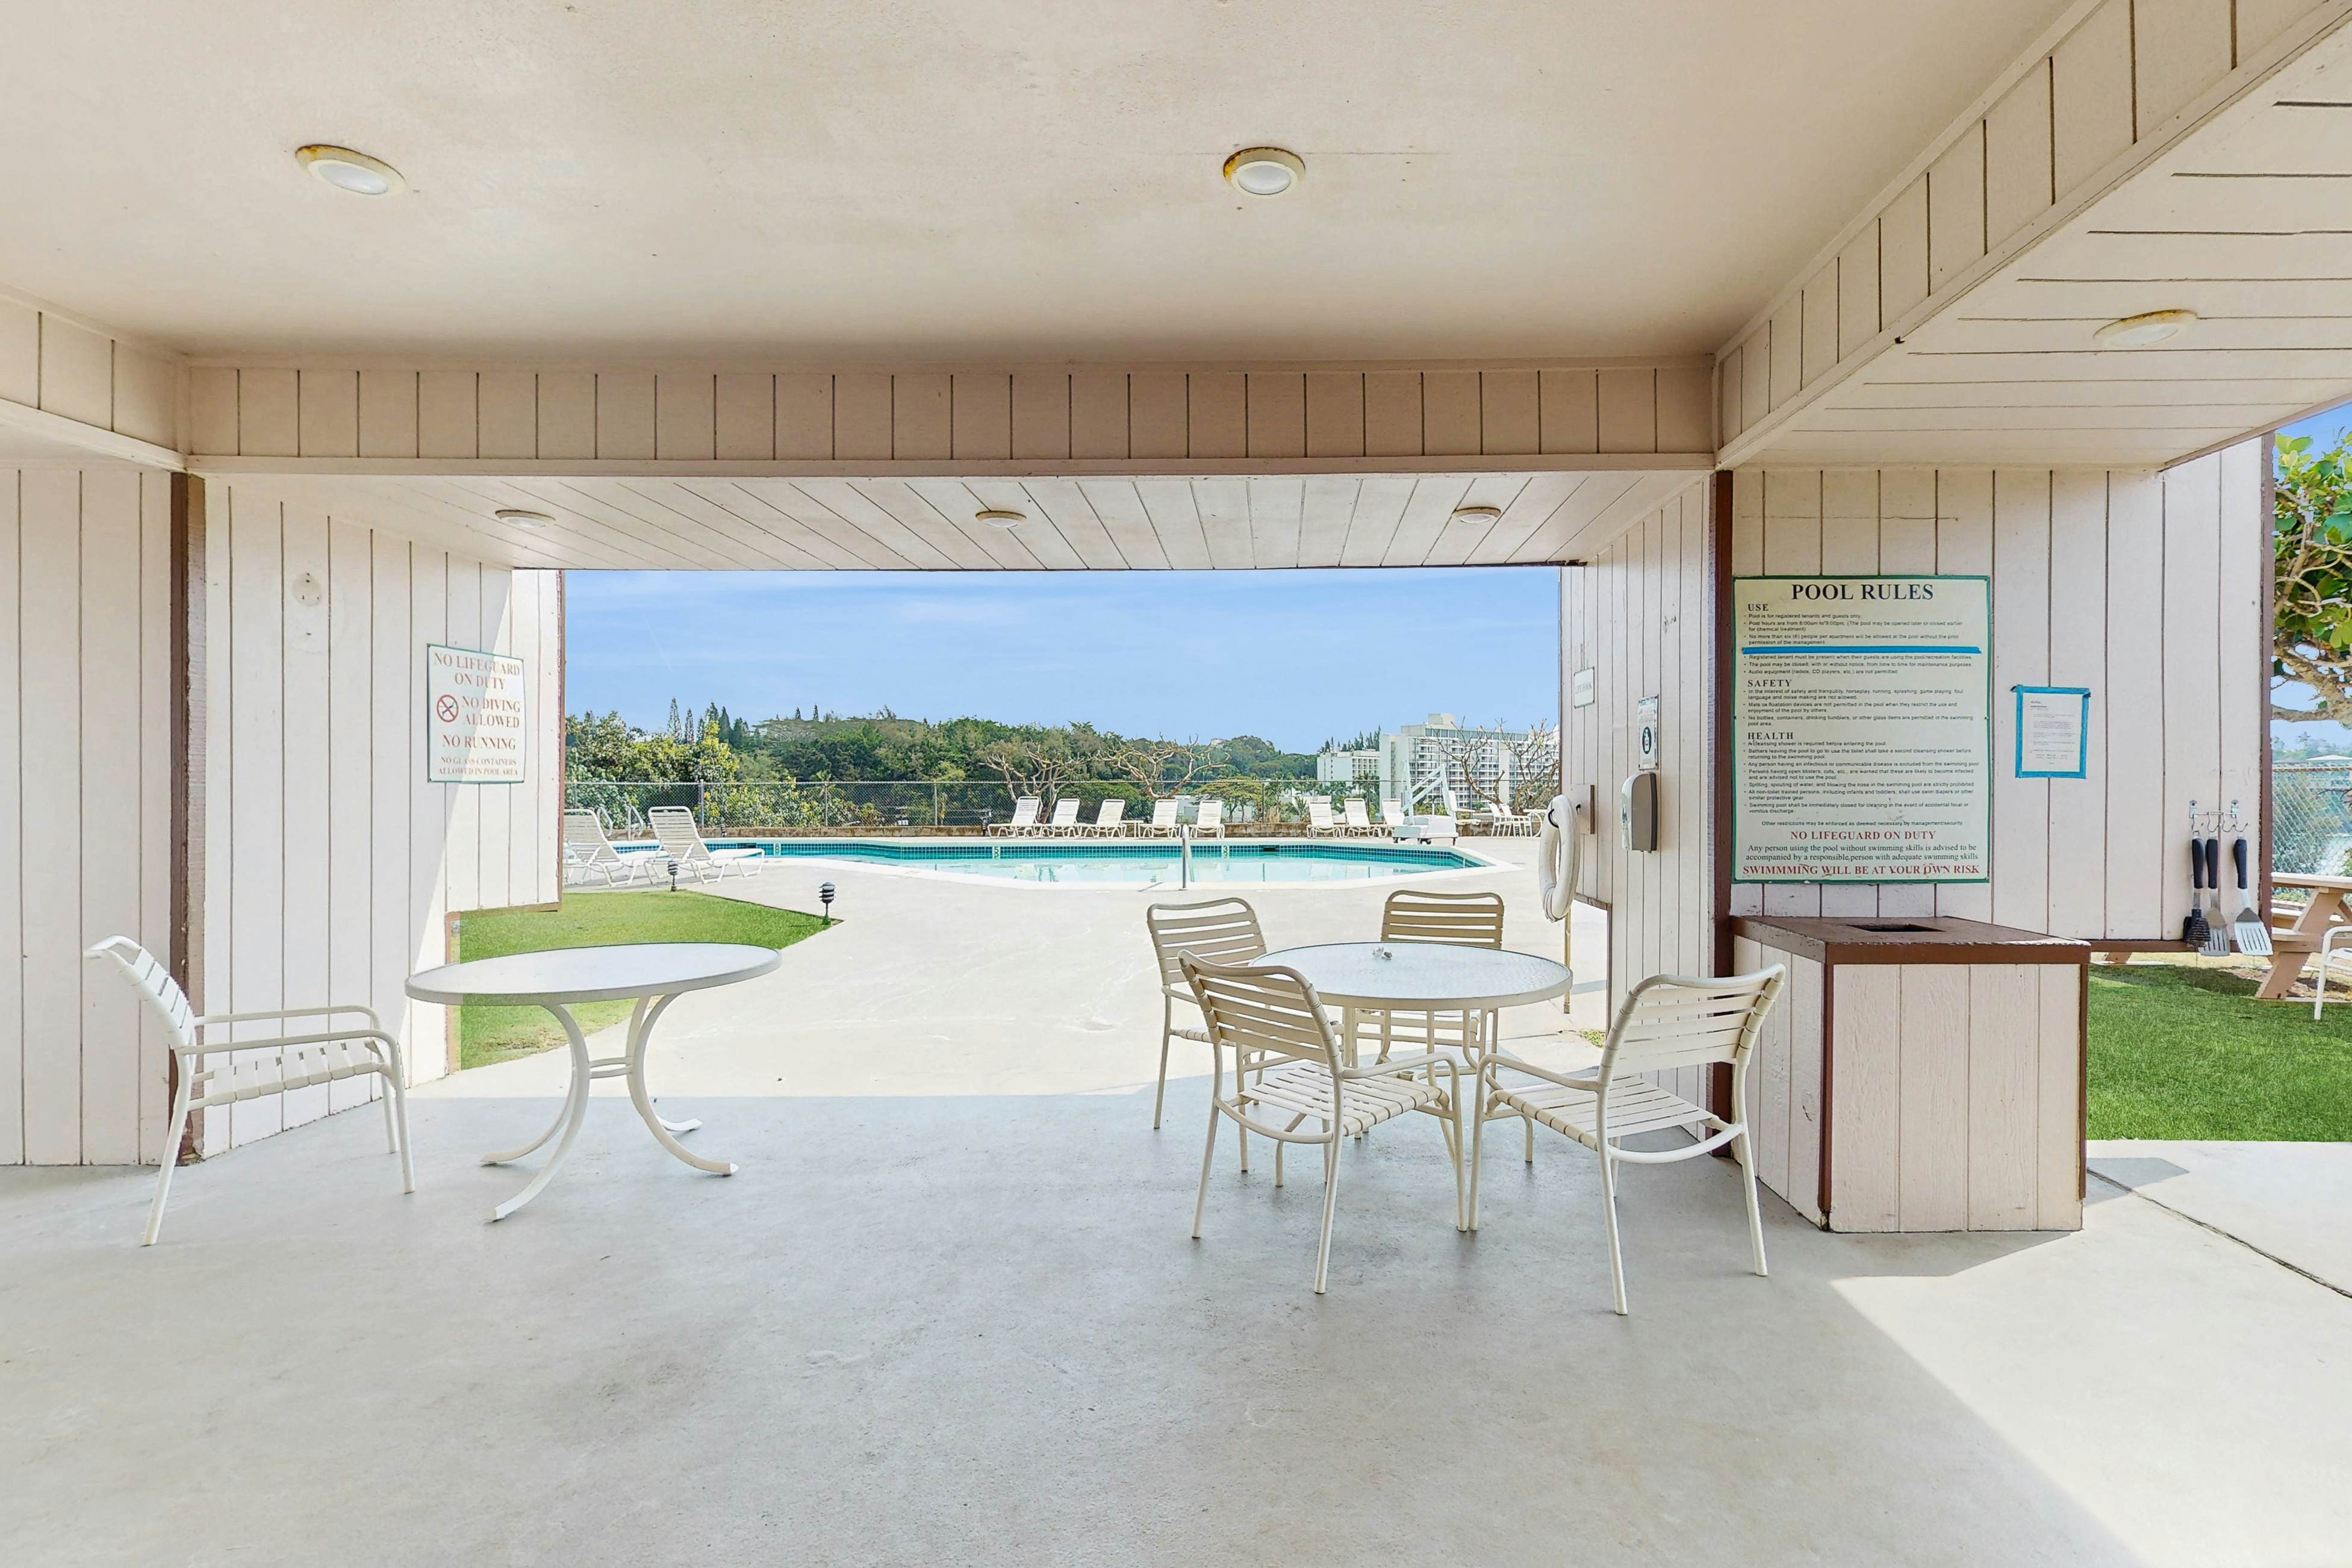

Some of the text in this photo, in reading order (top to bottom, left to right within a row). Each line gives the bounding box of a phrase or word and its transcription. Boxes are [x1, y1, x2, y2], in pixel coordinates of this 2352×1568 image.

[1791, 583, 1934, 600] POOL RULES
[434, 652, 520, 676] NO LIFEGUARD
[455, 673, 506, 690] ON DUTY
[462, 695, 521, 713] NO DIVING
[463, 714, 520, 728] ALLOWED
[443, 735, 516, 750] NO RUNNING
[1791, 831, 1935, 839] NO LIFEGUARD ON DUTY
[1823, 844, 1838, 853] pool
[1868, 844, 1903, 853] swimming
[1960, 844, 1967, 852] to
[1968, 844, 1976, 852] be
[1892, 853, 1922, 862] adequate
[1924, 853, 1958, 862] swimming
[1822, 866, 1851, 874] WILL
[1855, 866, 1868, 874] BE
[1872, 866, 1885, 874] AT
[1889, 866, 1920, 874] YOUR
[1954, 866, 1979, 874] RISK
